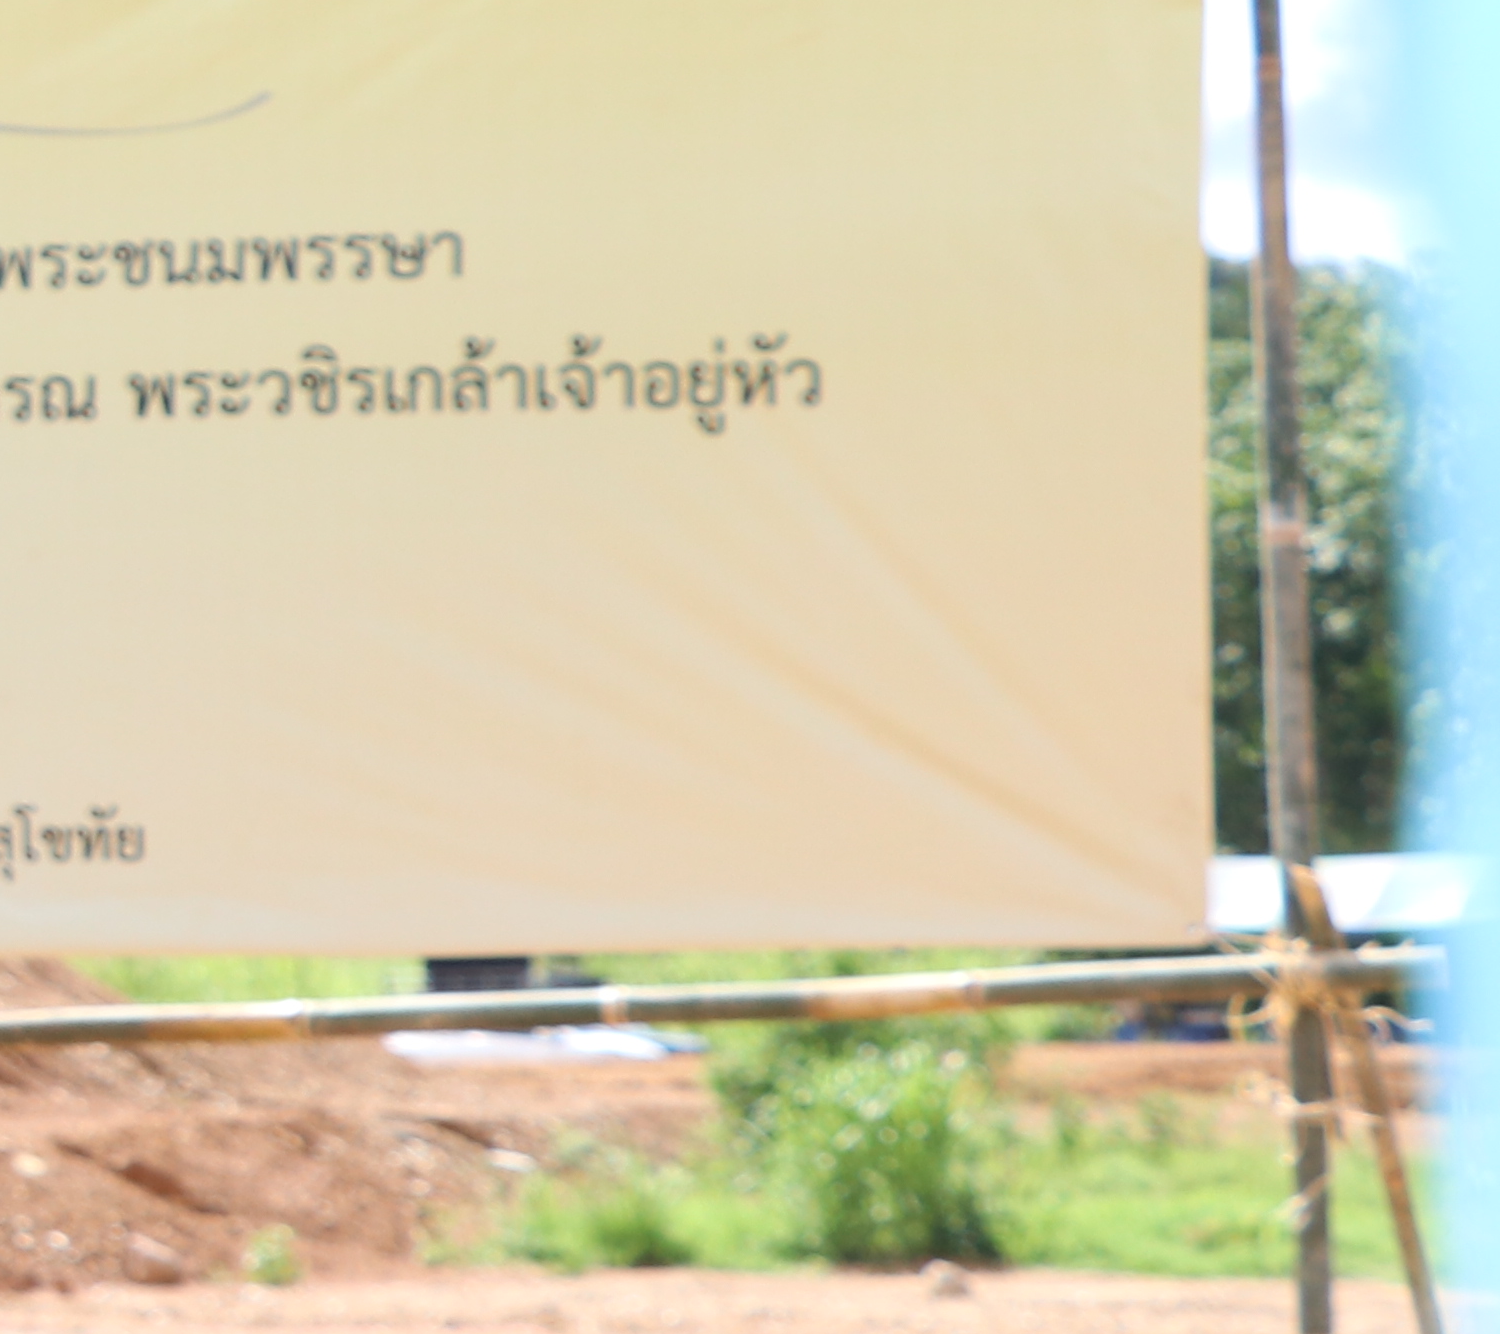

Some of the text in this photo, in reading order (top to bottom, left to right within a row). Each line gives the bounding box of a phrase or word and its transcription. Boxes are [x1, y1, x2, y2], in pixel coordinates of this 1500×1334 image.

[125, 332, 823, 437] พระวชิรเกล้าเจ้าอยู่หัว
